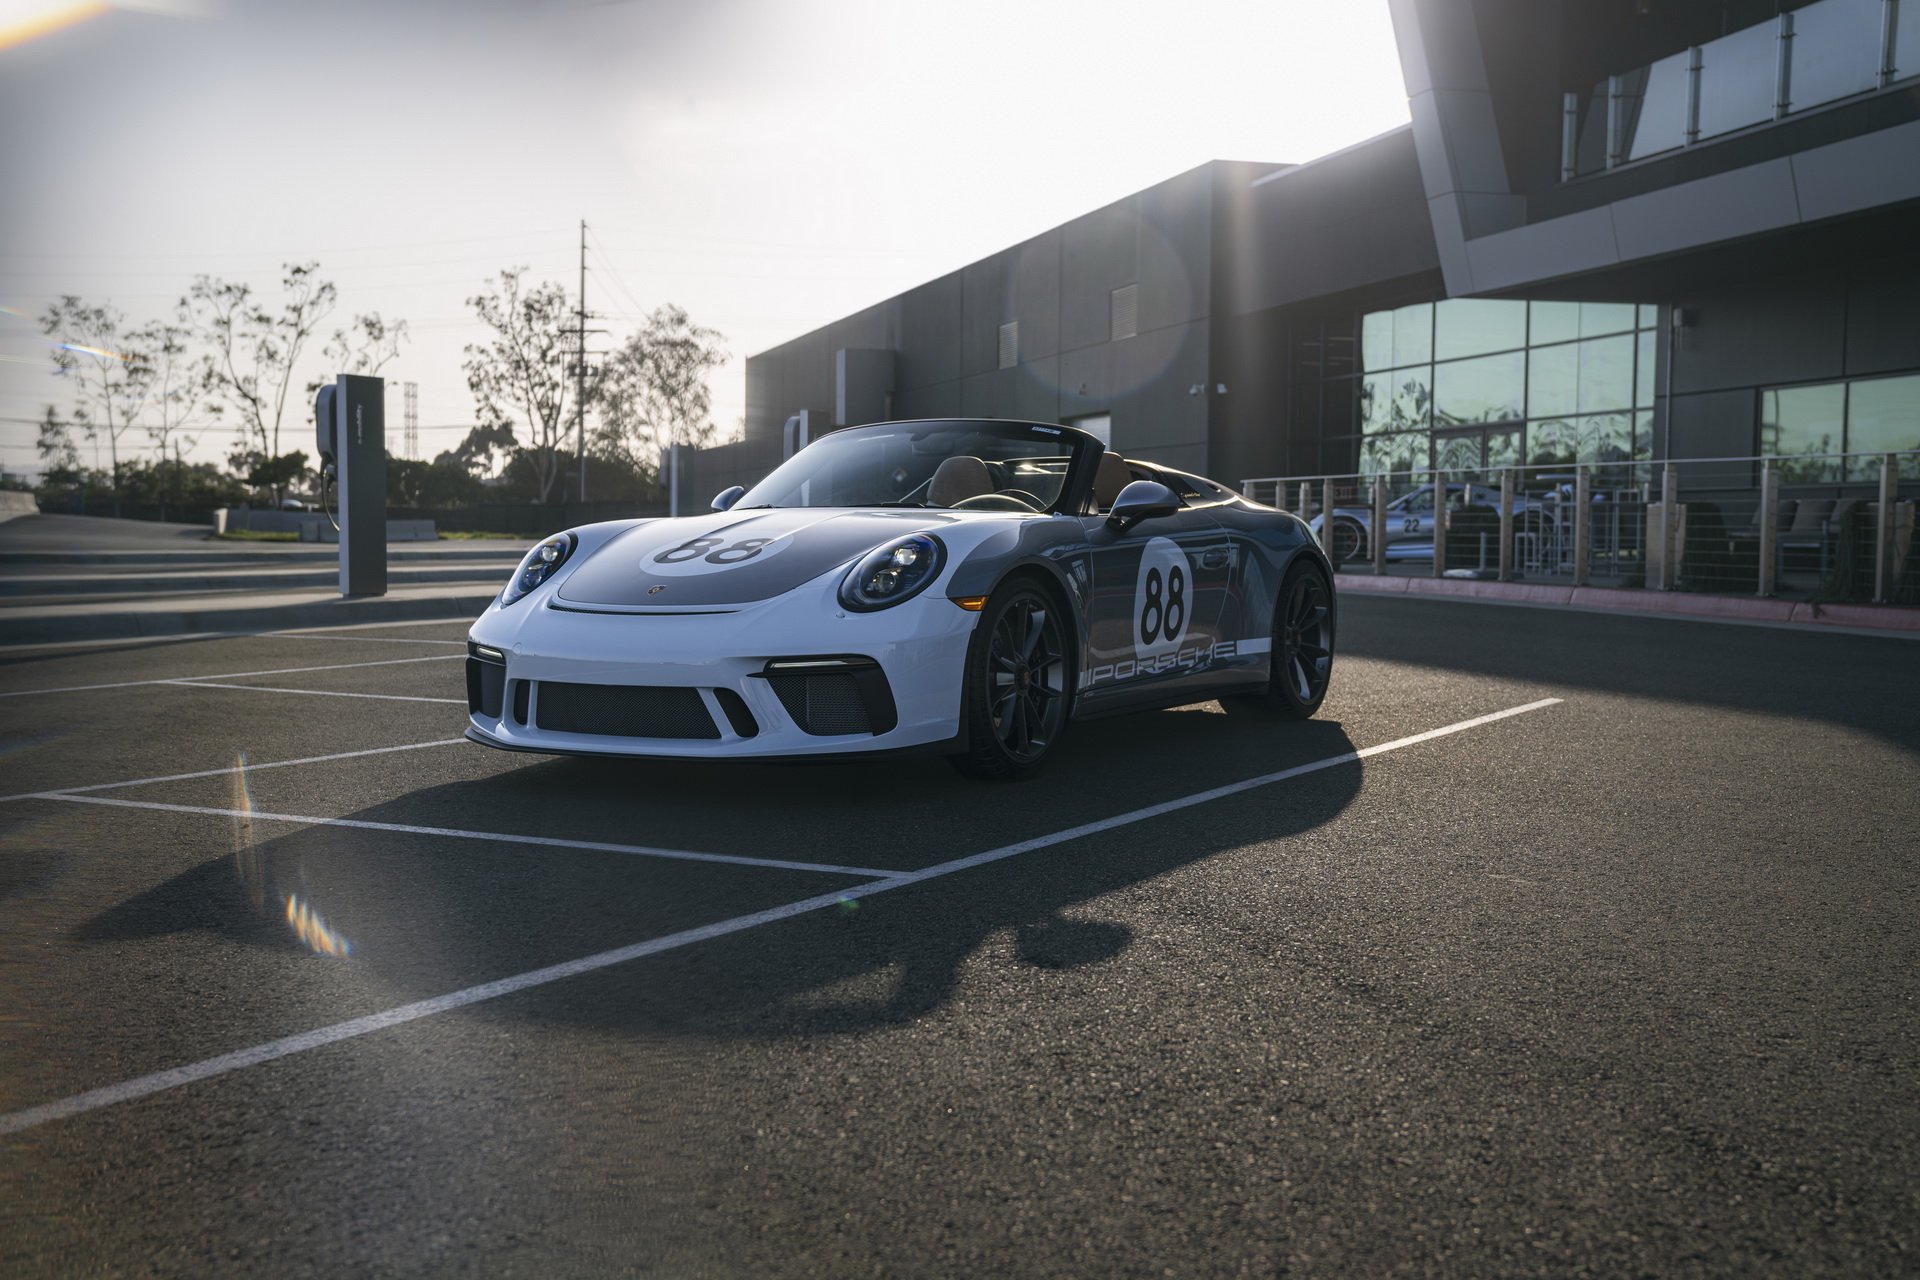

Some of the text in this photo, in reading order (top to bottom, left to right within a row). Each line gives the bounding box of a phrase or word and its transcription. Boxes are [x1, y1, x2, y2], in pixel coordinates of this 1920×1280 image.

[1404, 519, 1420, 533] 22
[653, 538, 776, 564] 88
[1141, 565, 1184, 645] 88
[1092, 641, 1235, 685] PORSCHE
